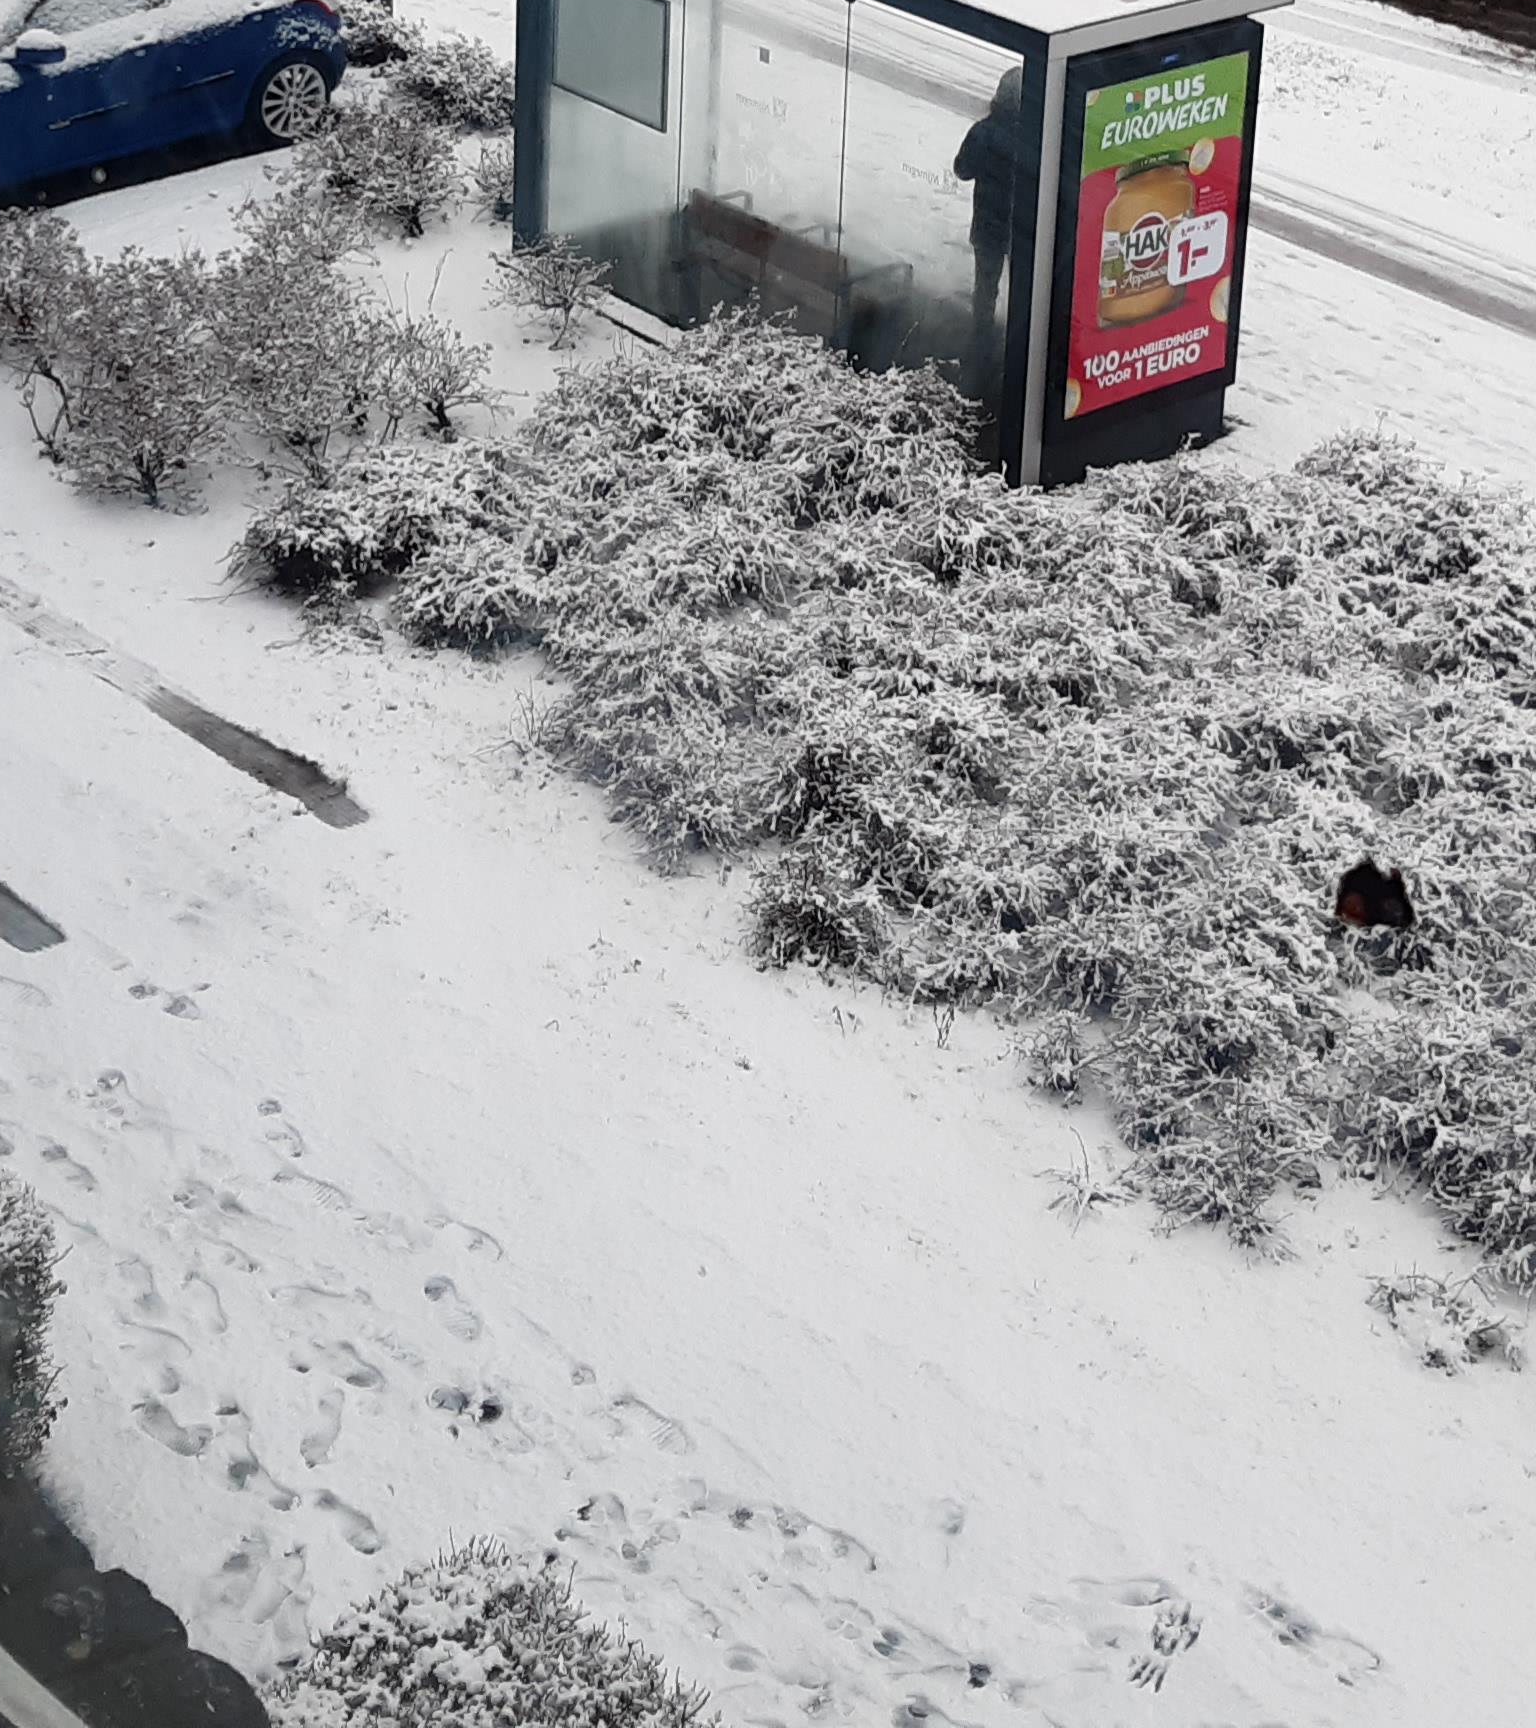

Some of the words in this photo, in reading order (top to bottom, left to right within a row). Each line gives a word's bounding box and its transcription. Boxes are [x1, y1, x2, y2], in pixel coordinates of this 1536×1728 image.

[1145, 74, 1206, 110] PLUS
[1100, 93, 1228, 151] EUROWEKEN
[1125, 225, 1169, 259] HAK
[1083, 350, 1120, 380] 100
[1121, 325, 1210, 364] AANBIEDINGEN
[1097, 367, 1131, 389] VOOR
[1134, 360, 1143, 381] 1
[1146, 343, 1201, 377] EURO
